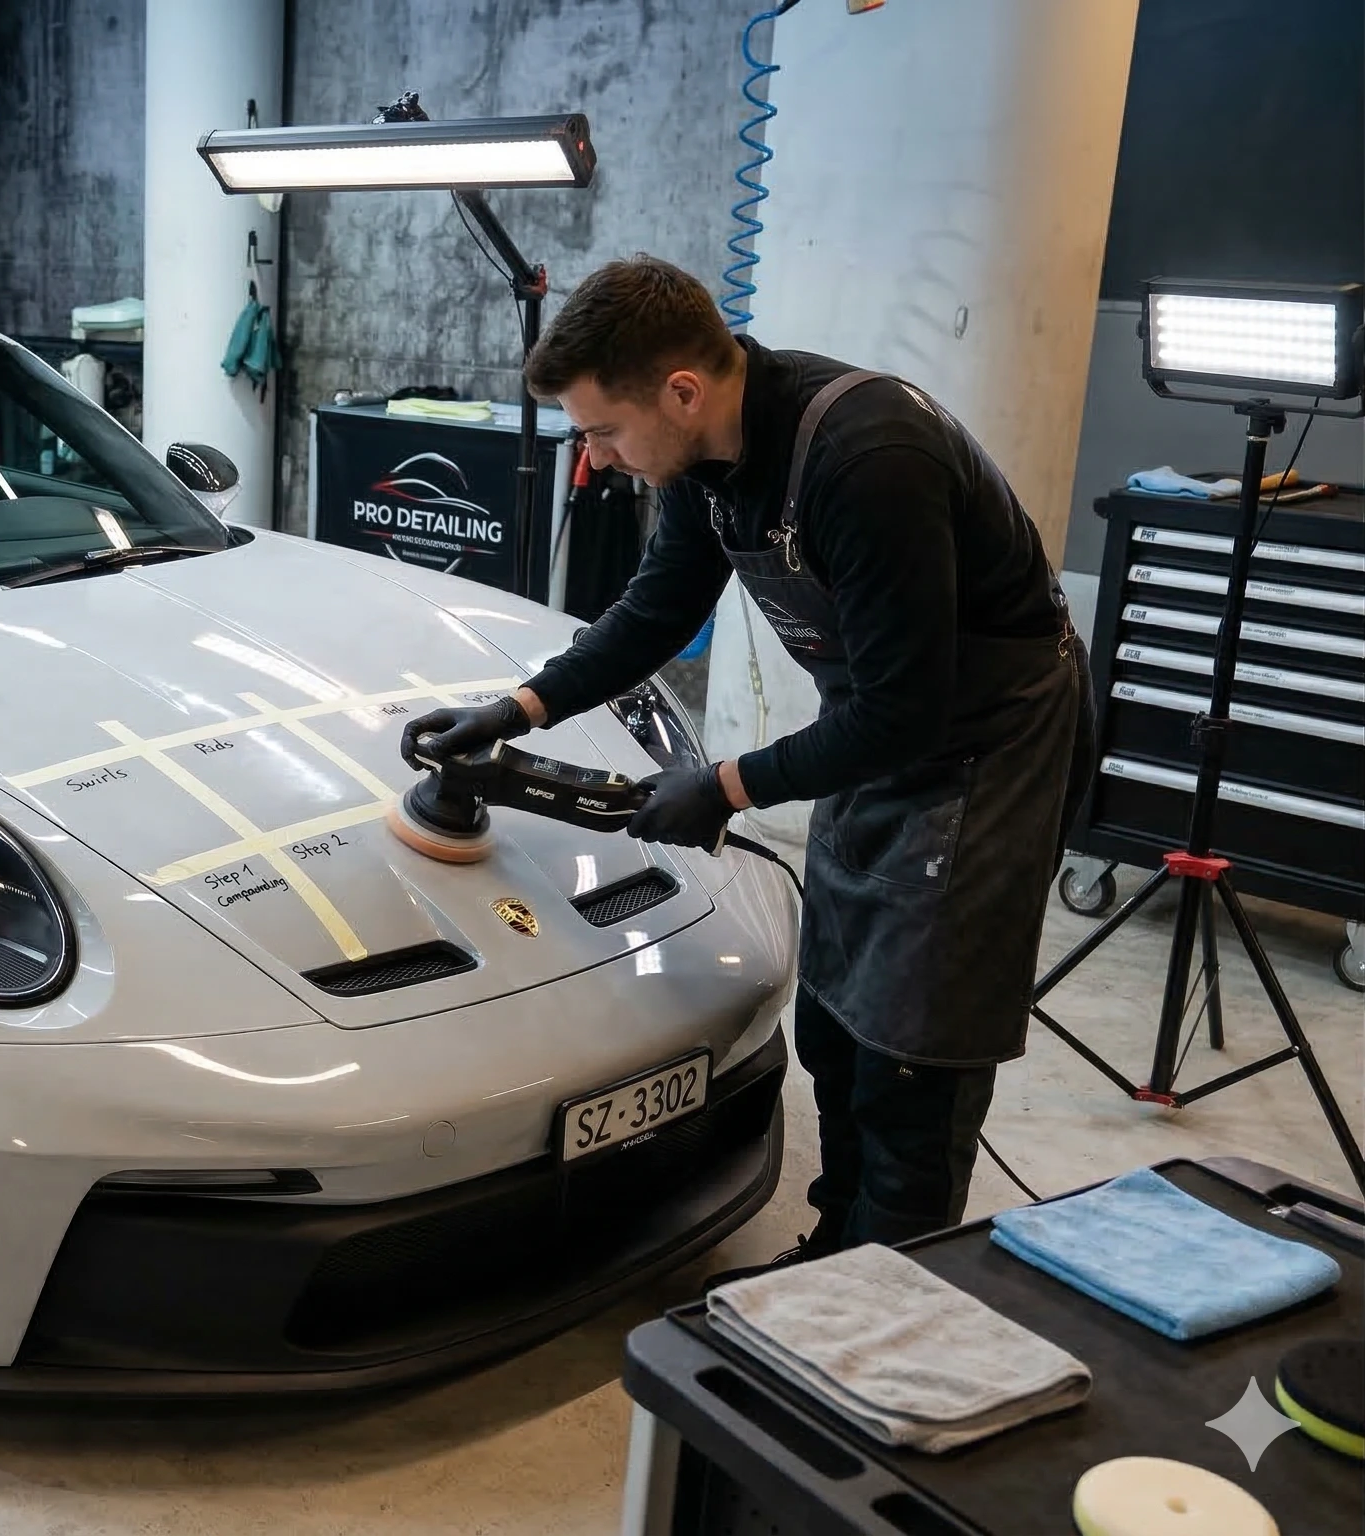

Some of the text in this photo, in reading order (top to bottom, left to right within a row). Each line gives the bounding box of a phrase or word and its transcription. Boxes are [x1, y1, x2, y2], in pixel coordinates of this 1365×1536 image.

[354, 500, 392, 525] PRO
[396, 506, 503, 543] DETAILING
[66, 767, 128, 792] Swirls
[292, 833, 349, 860] Step 2
[204, 863, 254, 890] Step 1
